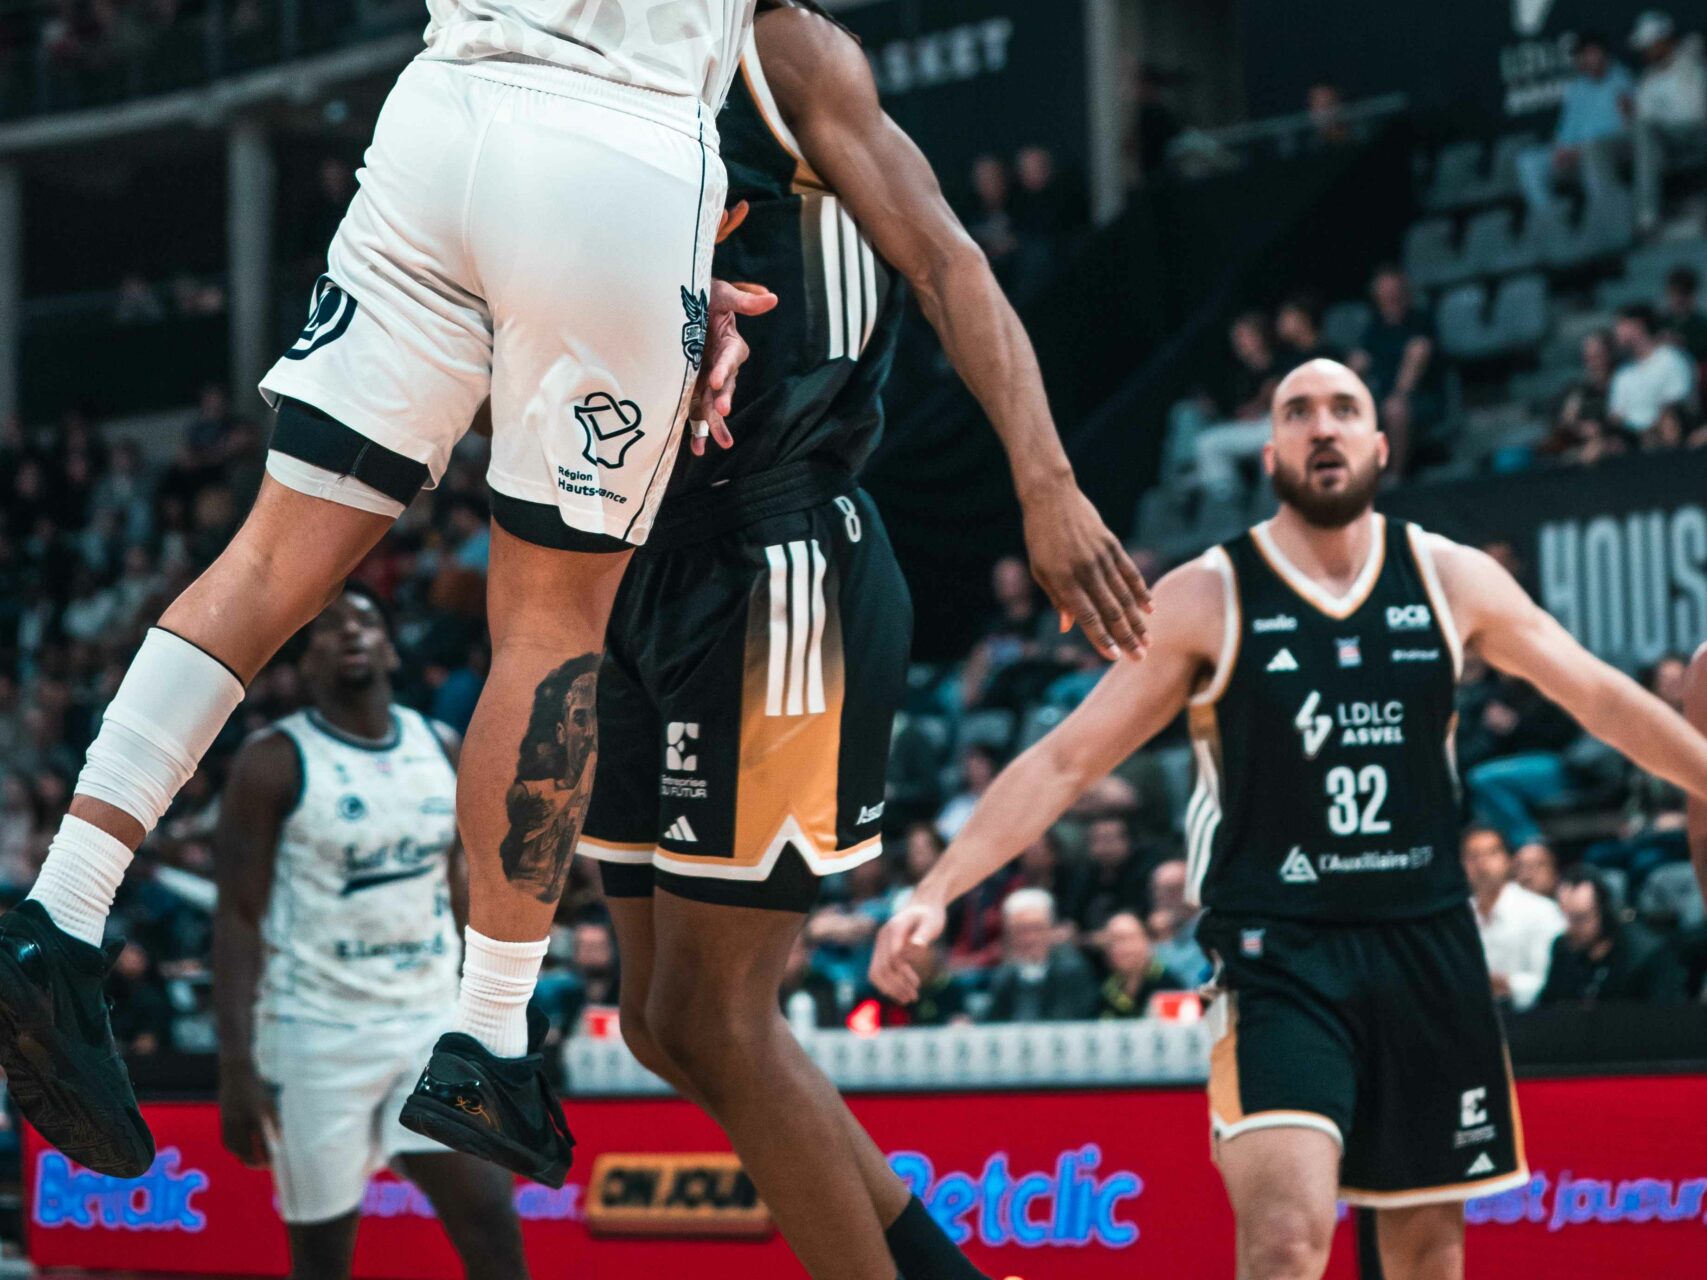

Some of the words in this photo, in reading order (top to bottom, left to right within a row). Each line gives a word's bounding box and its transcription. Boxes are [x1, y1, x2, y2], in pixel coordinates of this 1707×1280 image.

[558, 465, 593, 481] Région
[558, 477, 628, 504] Hauts-ance
[1338, 701, 1404, 726] LDLC
[1341, 726, 1404, 745] ASVEL
[1326, 764, 1391, 835] 32
[602, 1167, 660, 1208] ON
